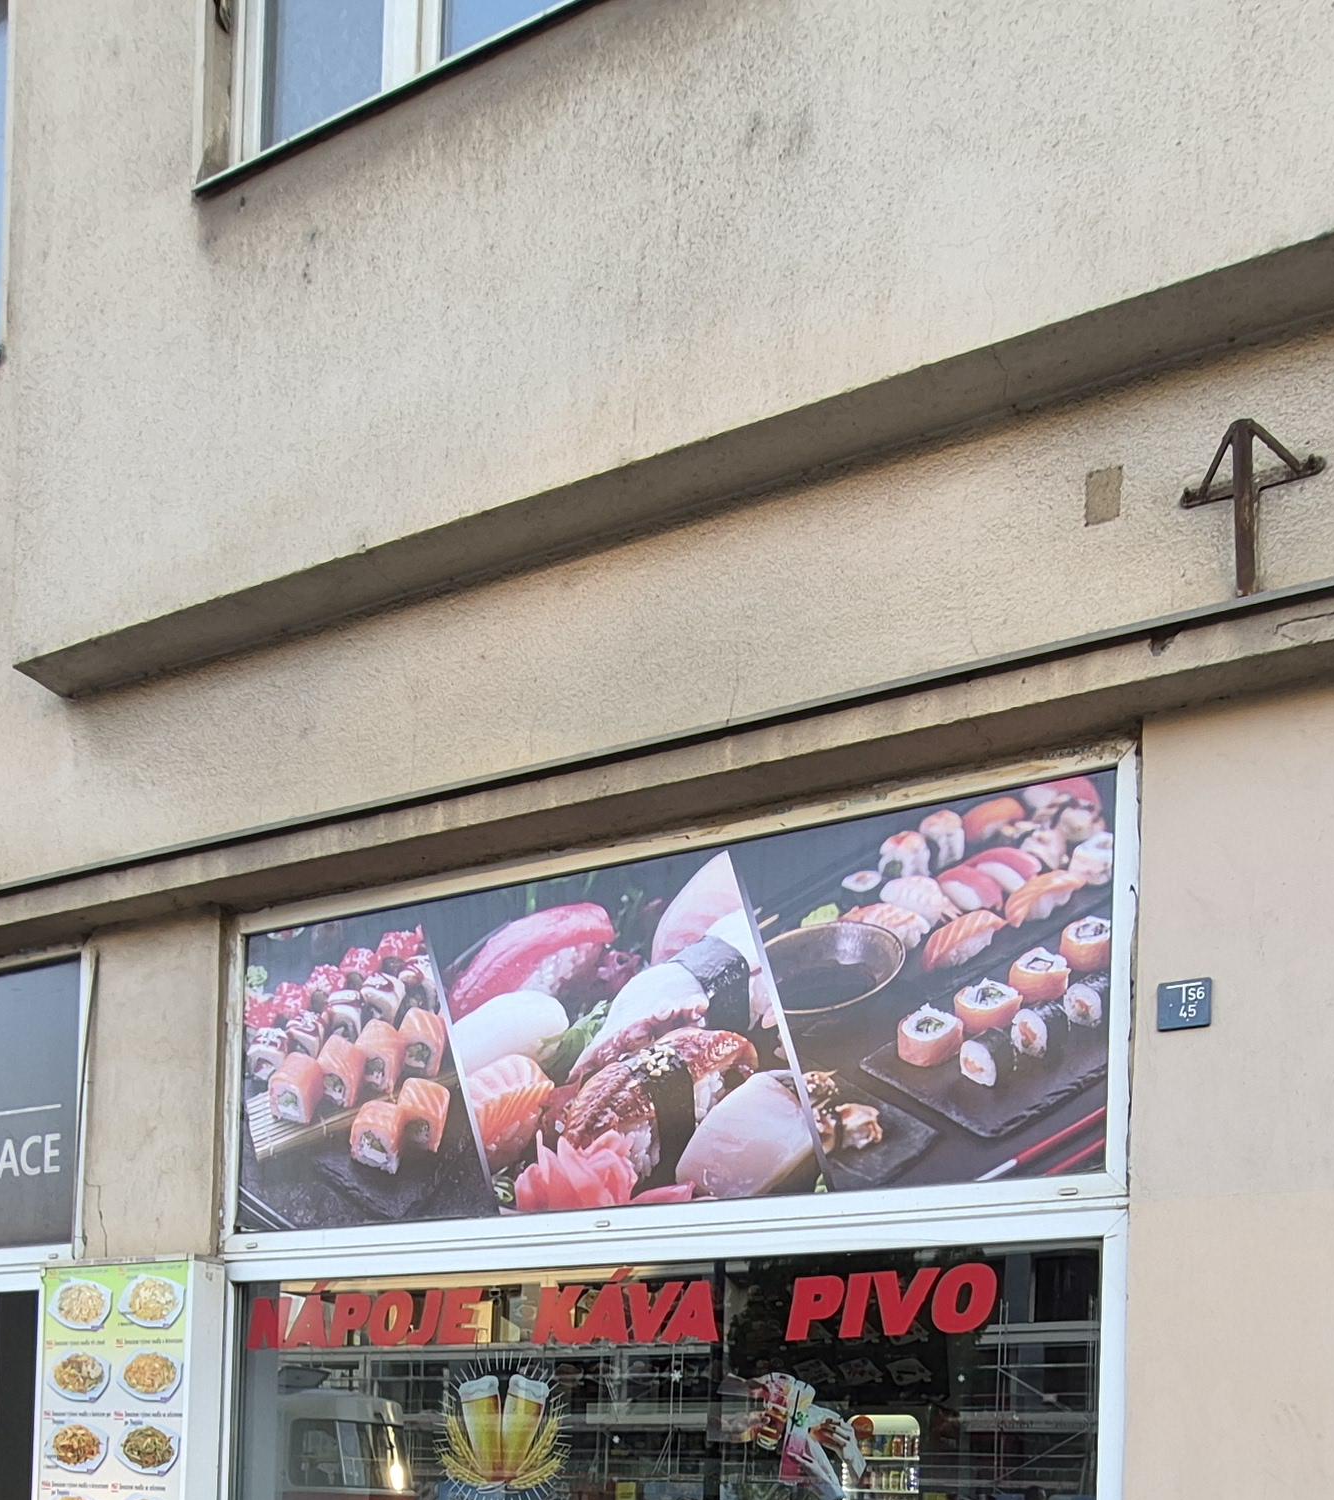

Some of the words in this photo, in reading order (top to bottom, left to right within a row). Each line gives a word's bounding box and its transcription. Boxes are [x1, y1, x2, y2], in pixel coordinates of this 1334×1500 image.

[1179, 1004, 1196, 1018] 45
[247, 1280, 484, 1349] NÁPOJE
[532, 1268, 718, 1345] KÁVA
[785, 1262, 999, 1342] PIVO
